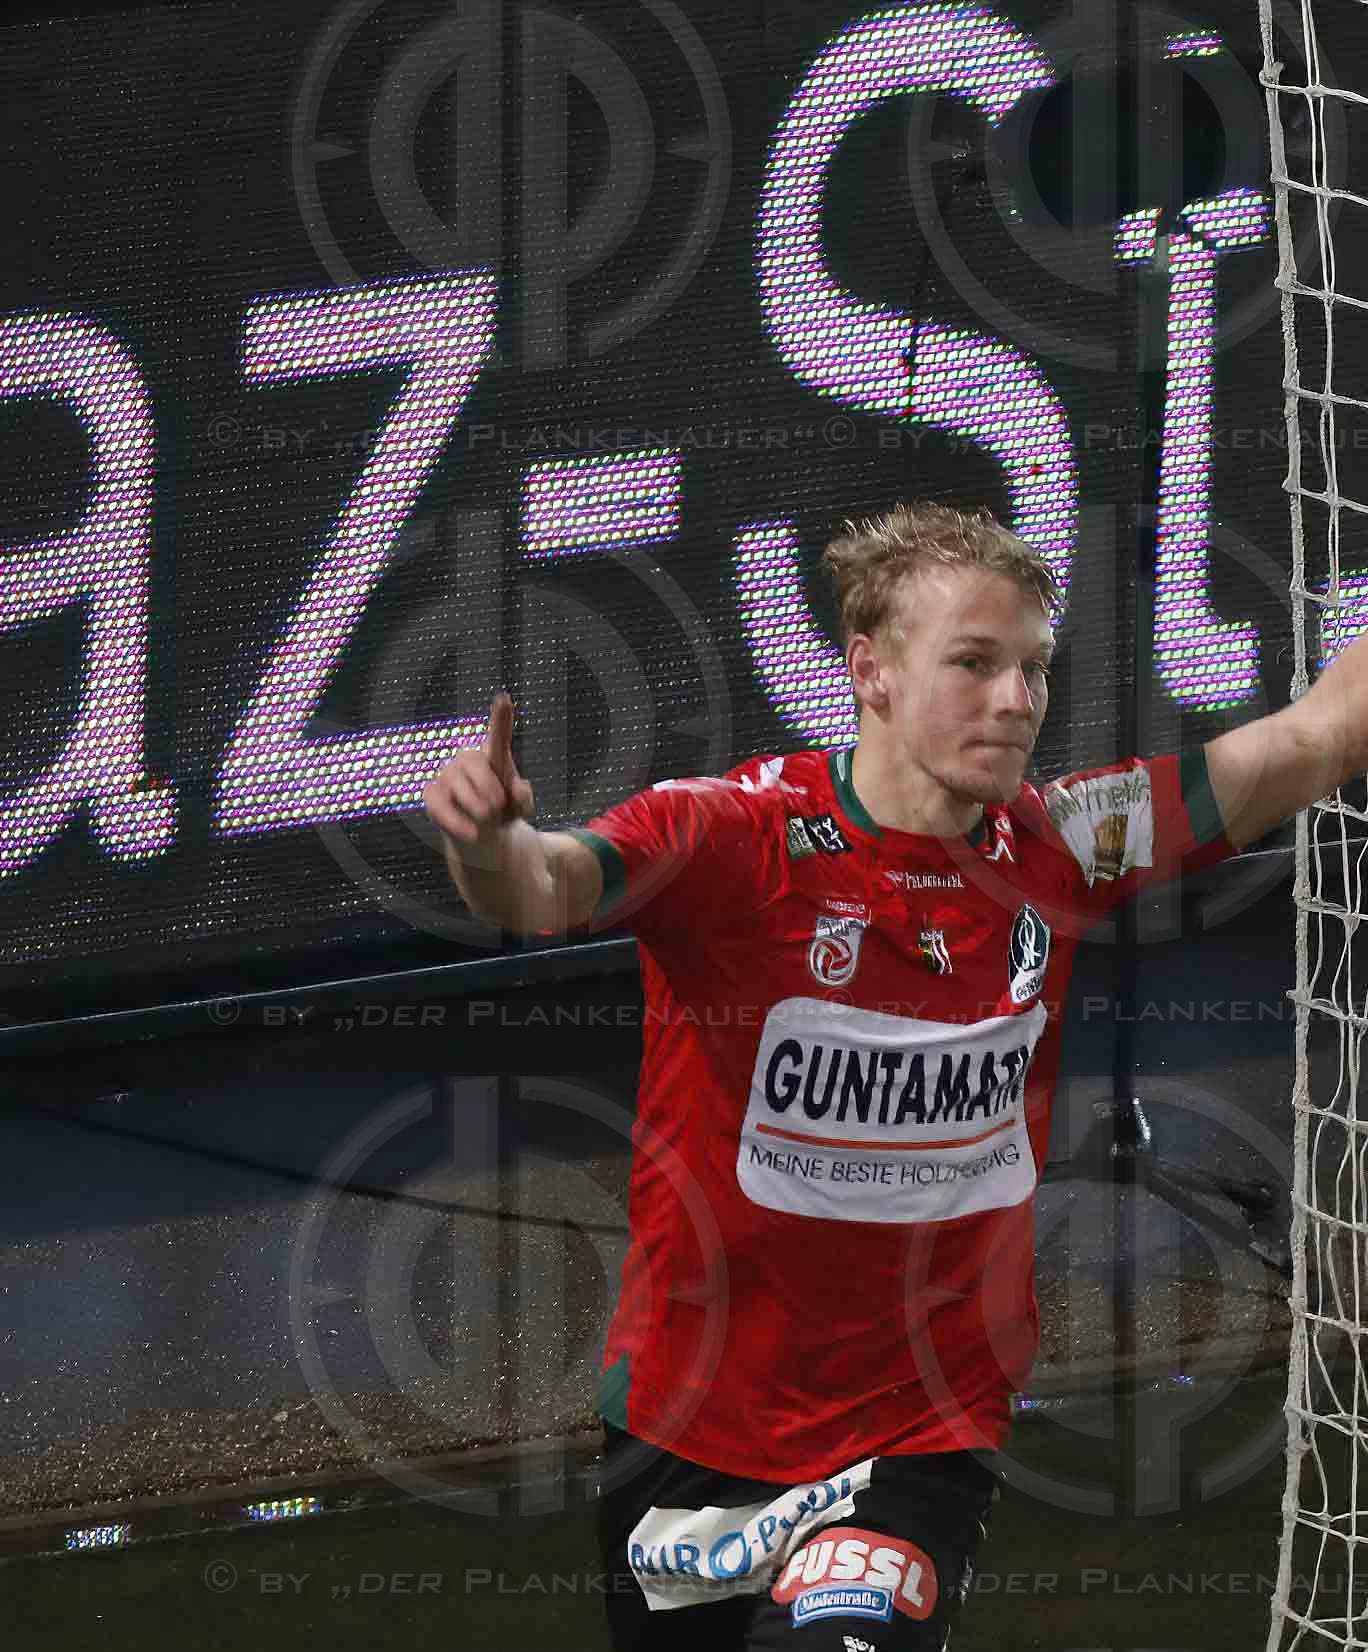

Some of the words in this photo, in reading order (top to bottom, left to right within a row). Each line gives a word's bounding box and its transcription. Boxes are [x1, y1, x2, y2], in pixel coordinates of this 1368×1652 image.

[750, 1144, 823, 1180] MEINE
[831, 1159, 895, 1185] BESTE
[779, 1539, 924, 1608] FUSSL
